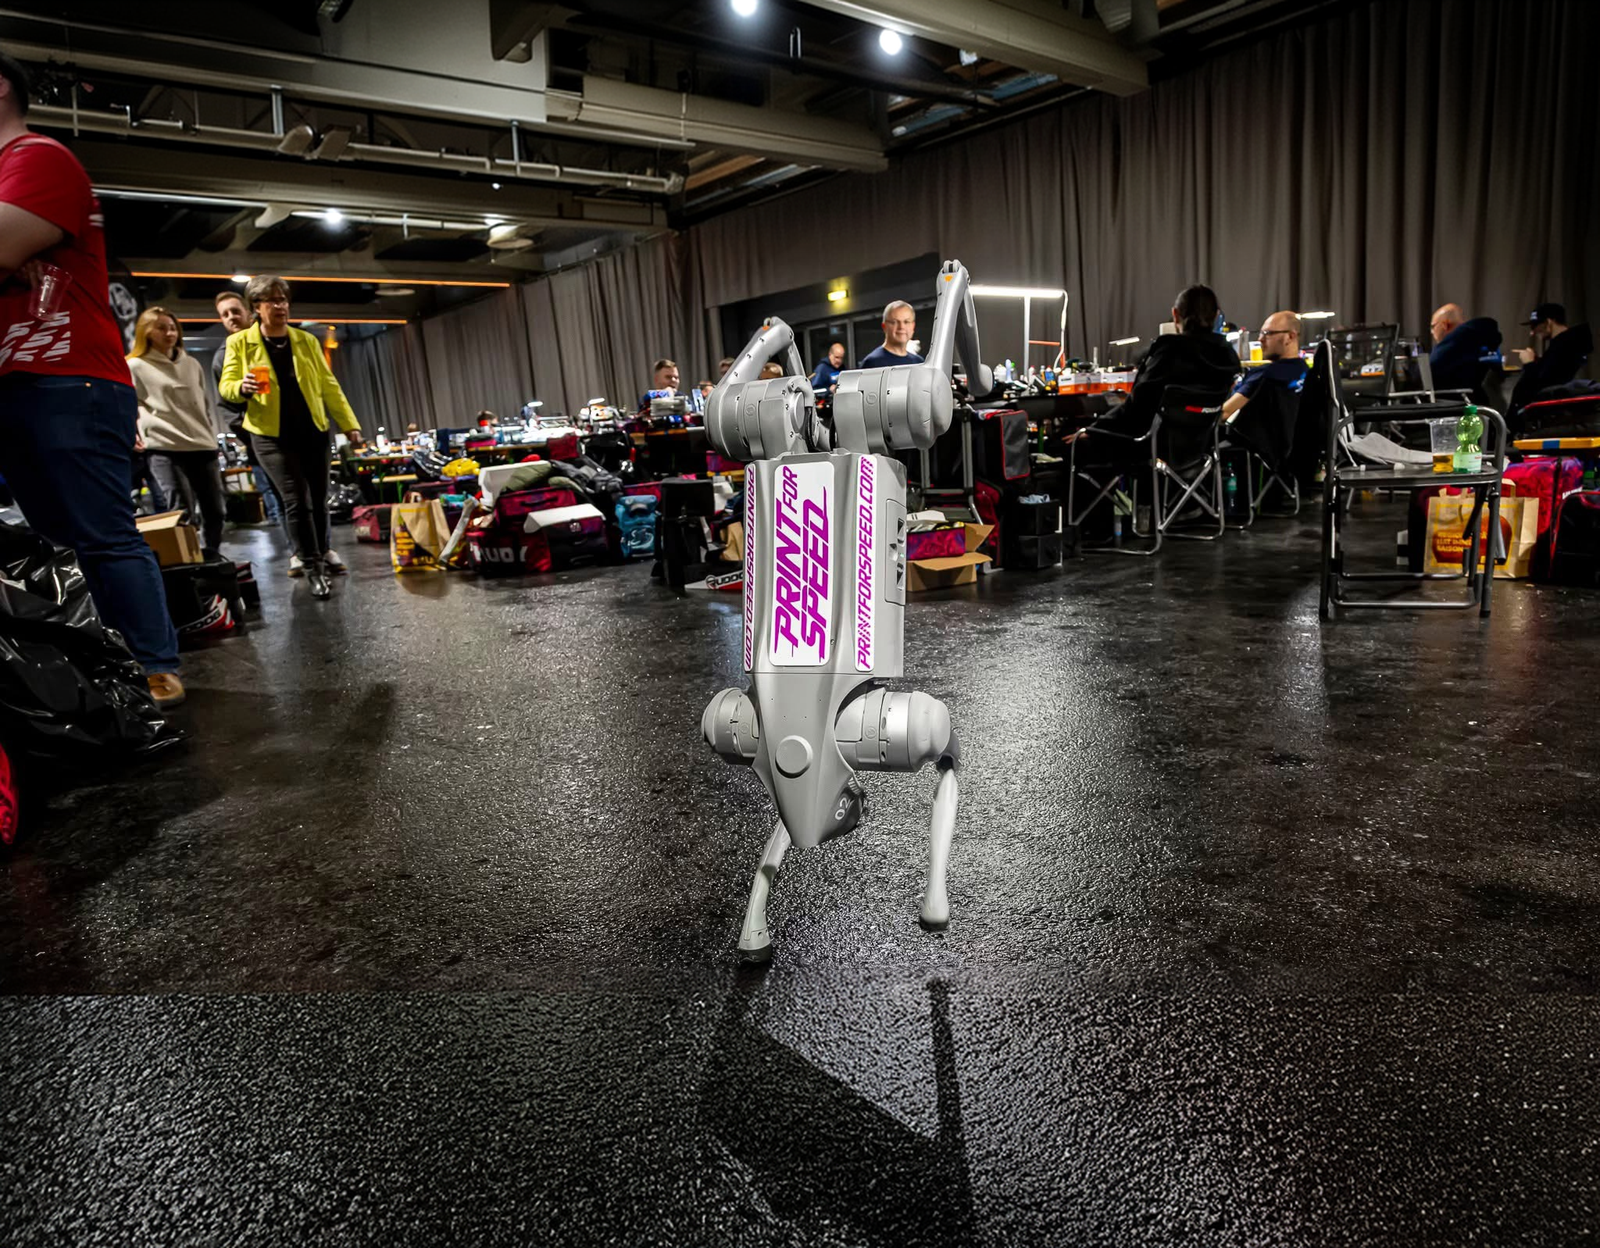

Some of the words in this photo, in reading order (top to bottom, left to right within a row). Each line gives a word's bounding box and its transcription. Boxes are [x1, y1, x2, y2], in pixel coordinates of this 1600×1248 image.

[782, 465, 798, 514] FOR
[857, 456, 875, 669] PRINTFORSPEED.COM
[774, 498, 801, 657] PRINT
[801, 486, 829, 663] SPEED
